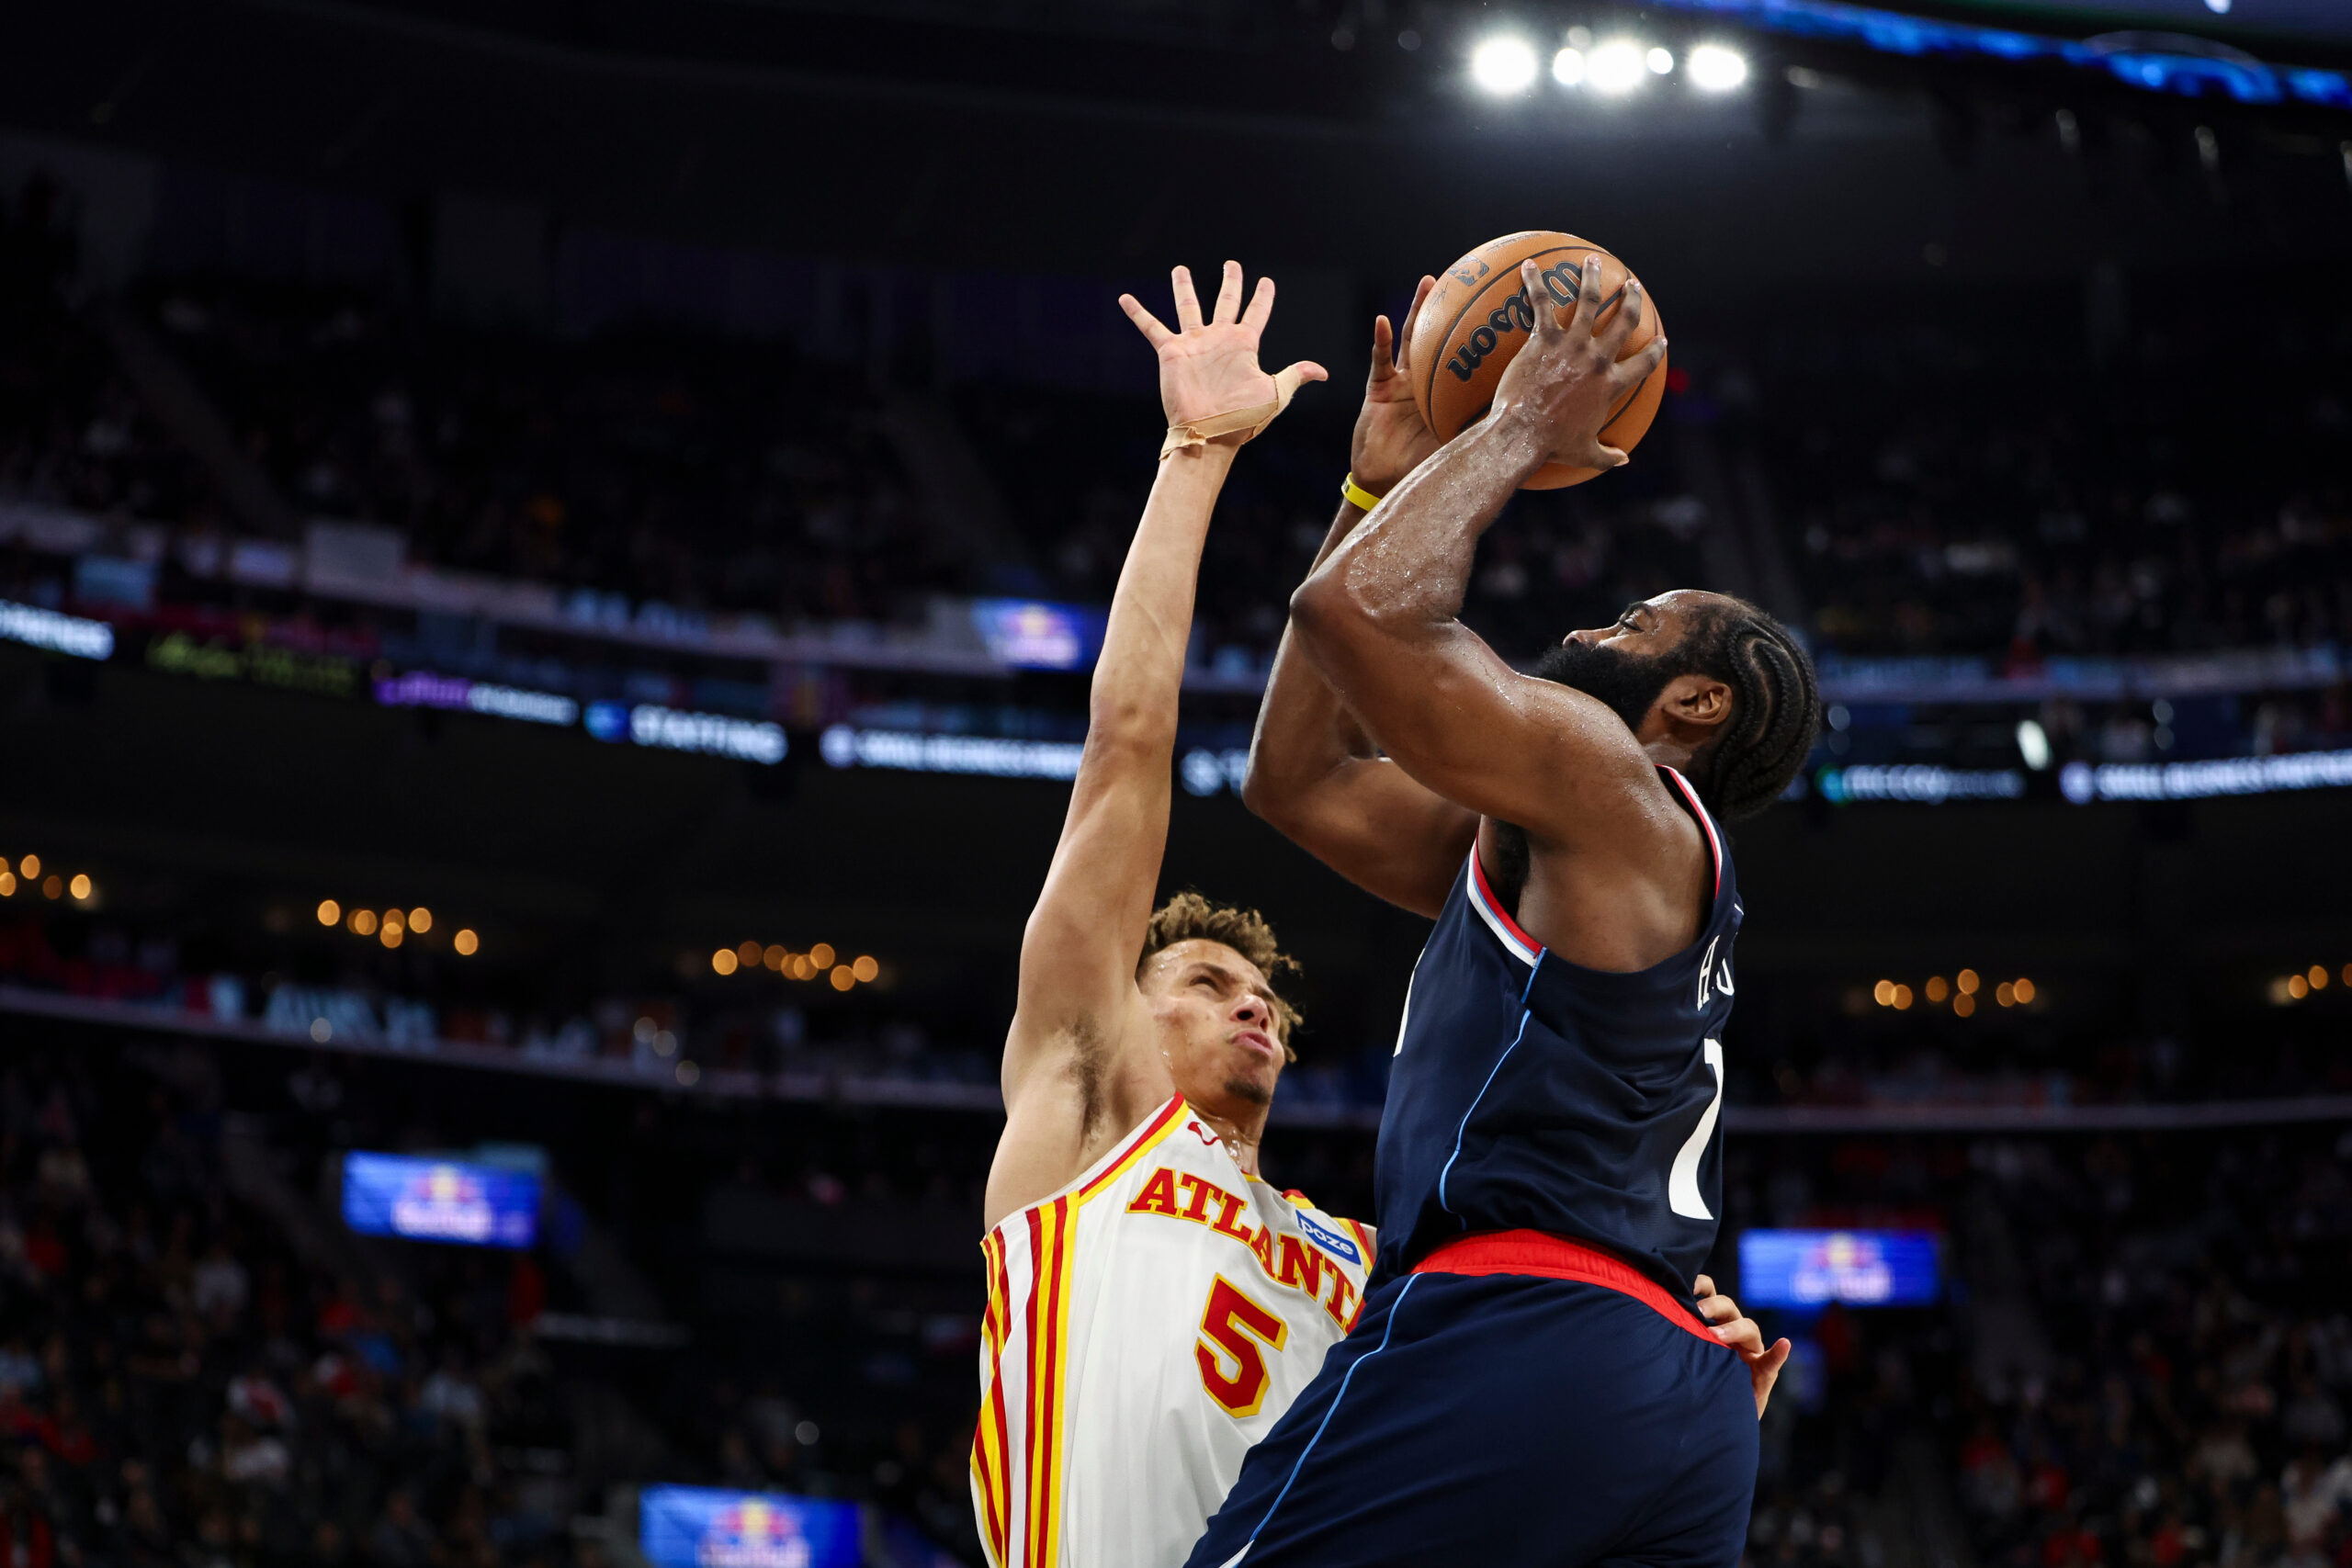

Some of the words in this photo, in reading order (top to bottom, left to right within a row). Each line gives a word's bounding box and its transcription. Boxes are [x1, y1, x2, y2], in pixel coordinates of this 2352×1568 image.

[1446, 260, 1583, 382] Wlson
[1301, 1217, 1354, 1256] paze
[1194, 1273, 1288, 1418] 5
